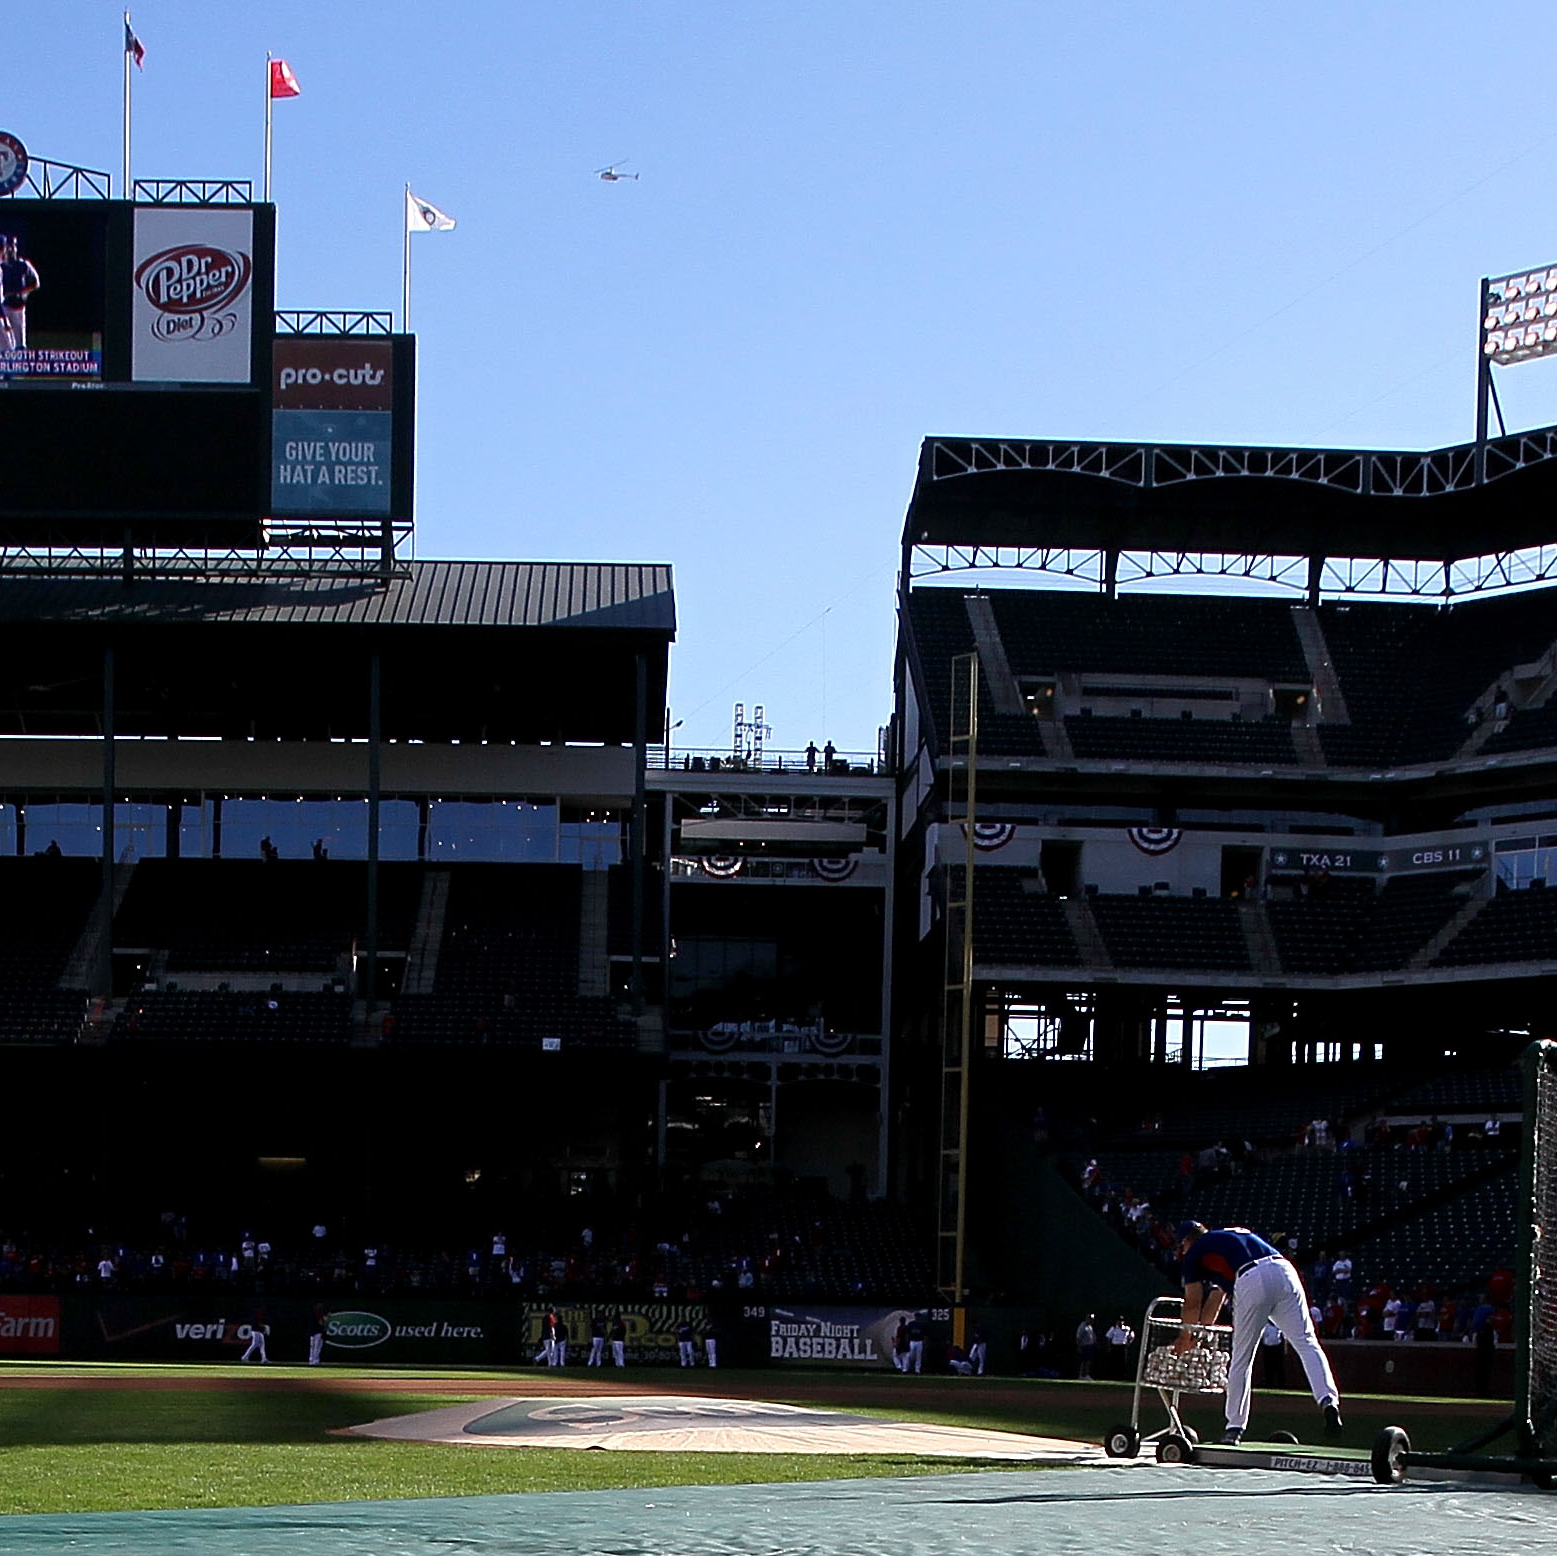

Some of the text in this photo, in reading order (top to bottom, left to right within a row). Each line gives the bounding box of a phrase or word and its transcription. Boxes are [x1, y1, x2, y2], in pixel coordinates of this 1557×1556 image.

[181, 255, 212, 280] Dr
[153, 260, 233, 304] Pepper
[166, 316, 193, 335] Diet
[38, 350, 89, 361] STRIKEOUT
[53, 361, 99, 373] STADIUM
[285, 442, 375, 462] GIVE YOUR
[280, 465, 383, 485] HAT A REST.
[1299, 853, 1351, 867] TXA 21
[1412, 848, 1461, 864] CBS 11
[743, 1306, 765, 1318] 349
[931, 1308, 950, 1321] 325
[326, 1320, 485, 1339] Scotts used here.
[770, 1337, 878, 1360] BASEBALL
